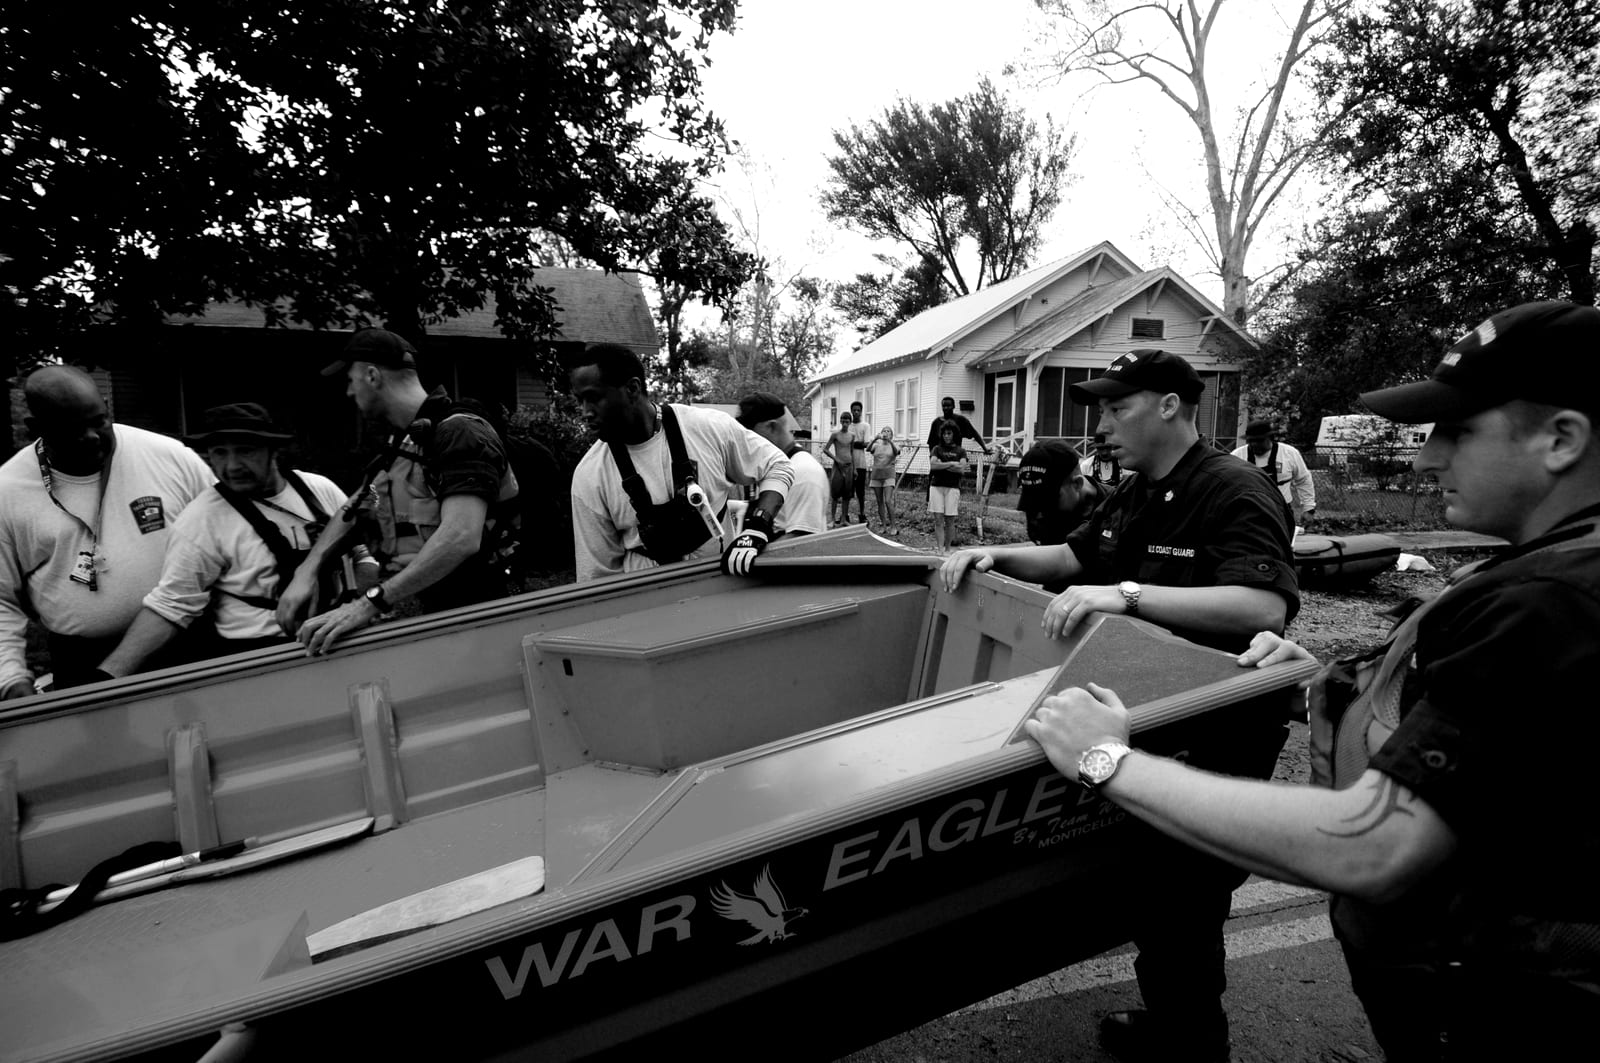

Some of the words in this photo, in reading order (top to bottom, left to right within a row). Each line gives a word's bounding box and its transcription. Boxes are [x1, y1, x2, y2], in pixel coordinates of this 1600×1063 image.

[1155, 545, 1172, 554] COAST
[1172, 547, 1195, 557] GUARD
[1013, 827, 1038, 844] By
[1047, 813, 1089, 833] Team
[1038, 812, 1126, 849] MONTICELLO
[485, 895, 697, 1000] WAR
[822, 773, 1068, 892] EAGLE
